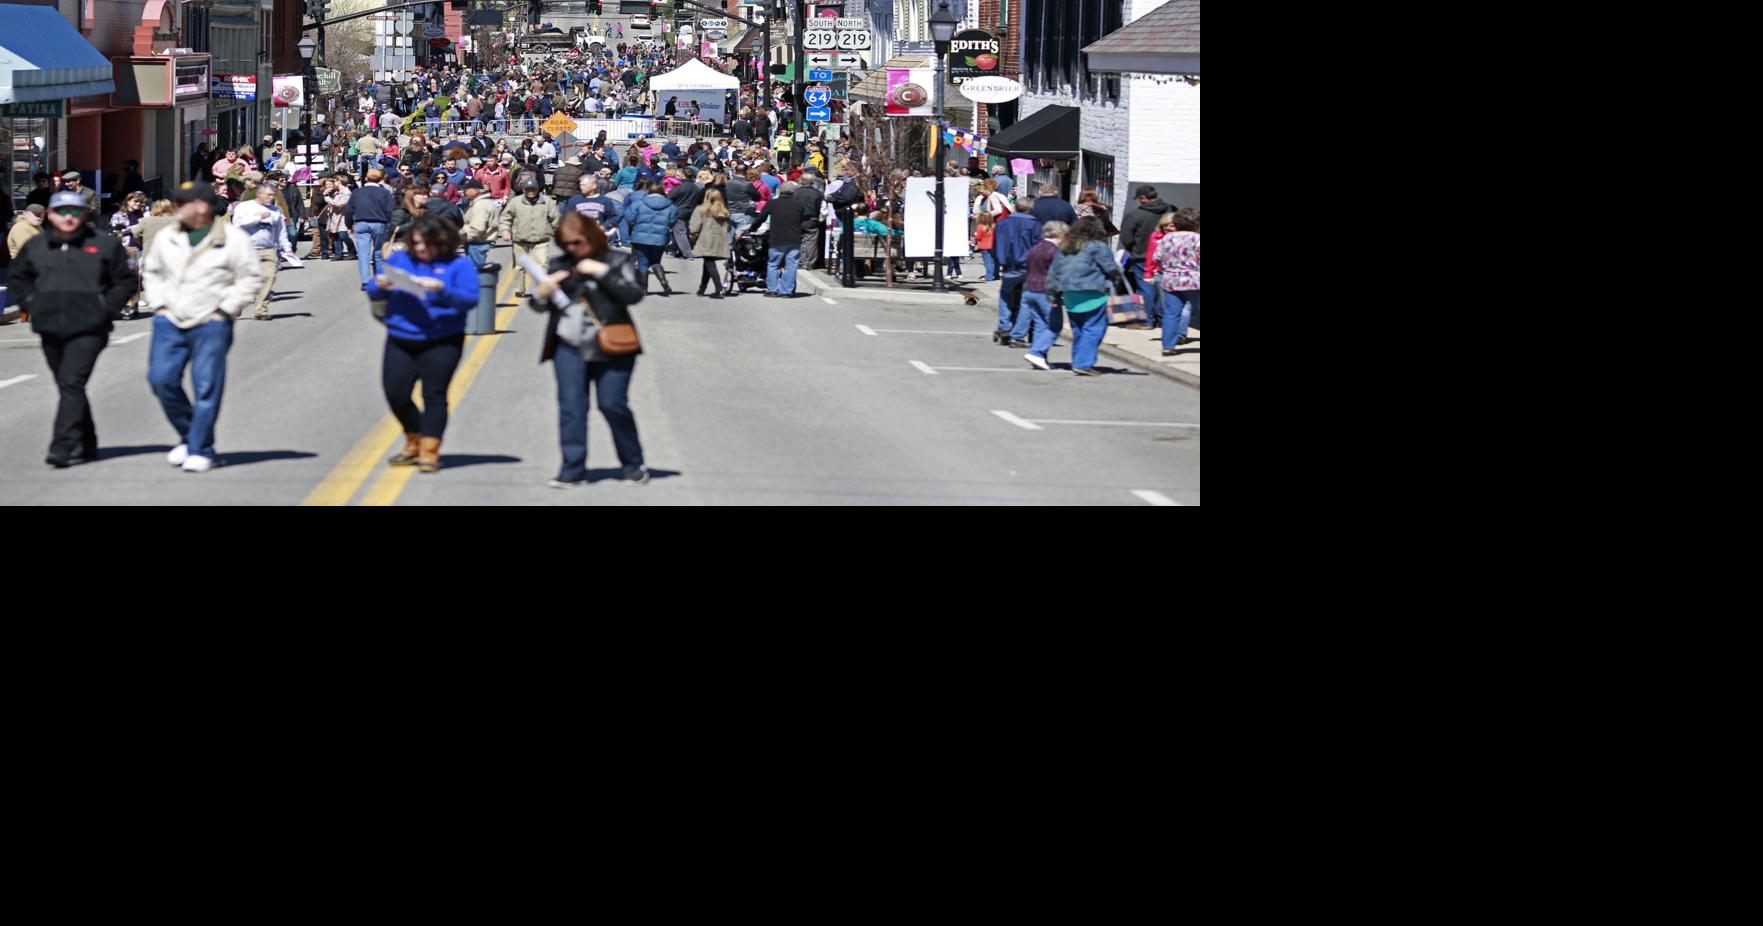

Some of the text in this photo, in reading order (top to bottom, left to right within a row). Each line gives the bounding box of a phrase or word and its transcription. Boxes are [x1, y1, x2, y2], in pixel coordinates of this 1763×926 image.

[808, 34, 831, 45] 219
[843, 34, 865, 45] 219
[950, 39, 999, 53] EDITH'S
[808, 93, 828, 103] 64
